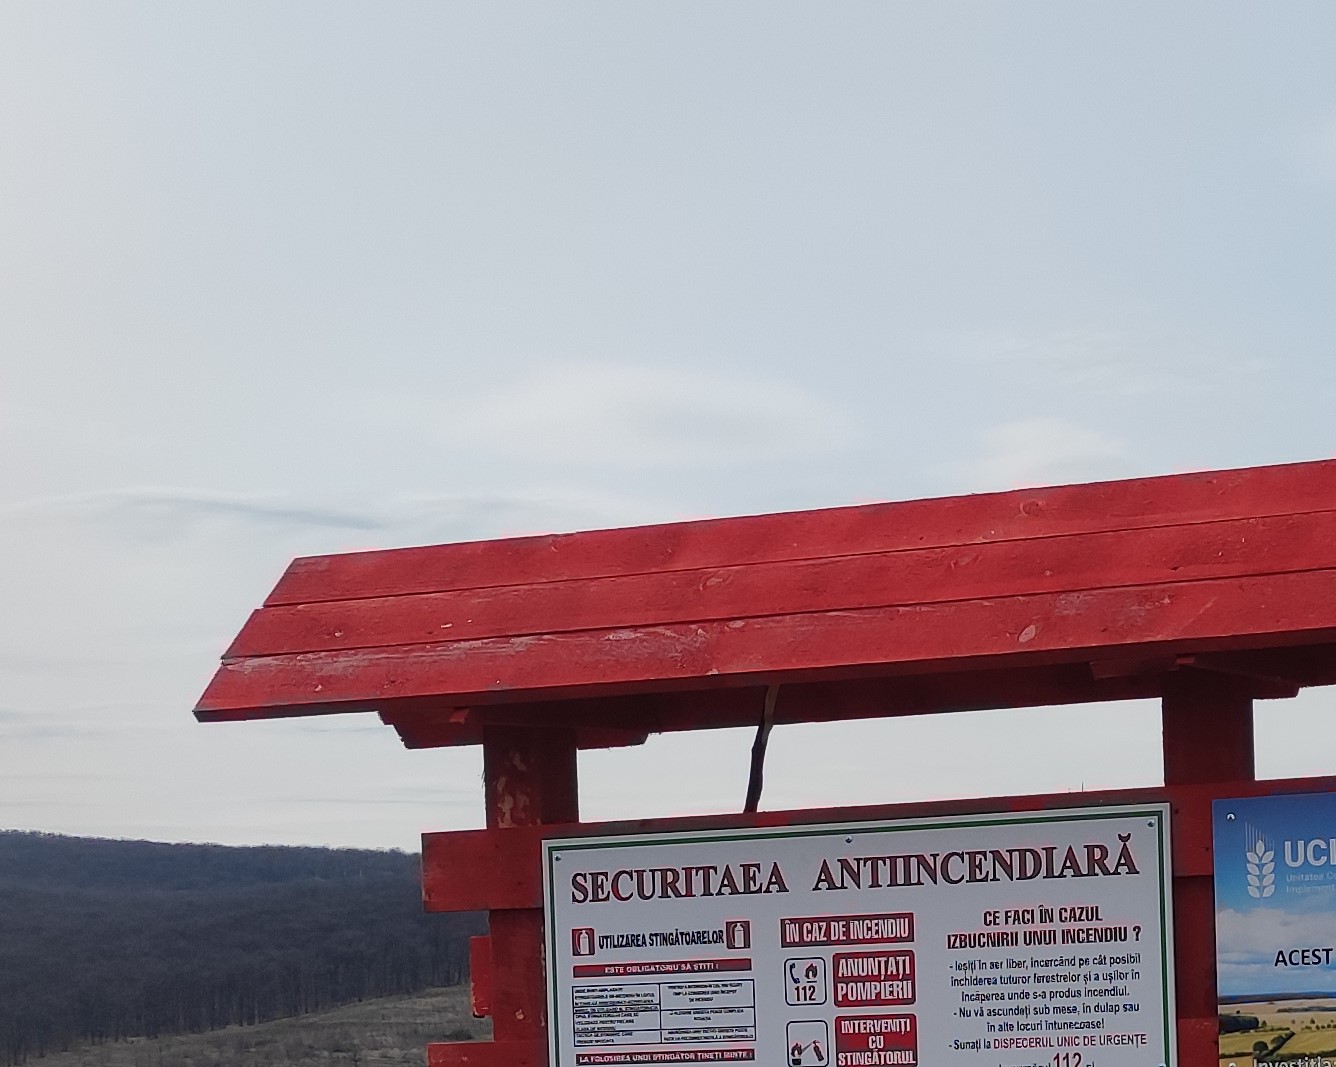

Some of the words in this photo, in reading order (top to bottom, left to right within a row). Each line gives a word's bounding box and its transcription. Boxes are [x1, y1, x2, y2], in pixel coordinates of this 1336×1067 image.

[572, 862, 789, 904] SECURITAEA
[812, 832, 1140, 891] ANTIINCENDIARĂ
[984, 911, 1000, 926] CE
[1005, 909, 1034, 925] FACI
[1038, 904, 1053, 923] ÎN
[1059, 906, 1103, 923] CAZUL
[599, 934, 647, 949] UTILIZAREA
[649, 929, 724, 946] STINGĂTOARELOR
[785, 920, 798, 942] ÎN
[803, 922, 827, 941] CAZ
[831, 921, 846, 940] DE
[947, 932, 1018, 949] IZBUCNIRII
[1024, 930, 1057, 946] UNUI
[1062, 927, 1127, 944] INCENDIU
[1006, 958, 1028, 970] liber,
[1109, 953, 1140, 967] posibil
[1274, 948, 1333, 967] ACEST
[838, 956, 910, 980] ANUNȚAȚI
[1000, 974, 1030, 985] tuturor
[794, 986, 816, 1001] 112
[838, 981, 912, 1001] POMPIERII
[1008, 989, 1030, 1000] unde
[1050, 988, 1081, 1000] produs
[959, 1007, 971, 1018] Nu
[1033, 1004, 1050, 1015] sub
[1094, 1002, 1119, 1014] dulap
[1123, 1003, 1139, 1012] sau
[842, 1019, 910, 1034] INTERVENIȚI
[998, 1021, 1014, 1031] alte
[1017, 1019, 1042, 1031] locuri
[868, 1036, 884, 1048] CU
[994, 1035, 1054, 1049] DISPECERUL
[1057, 1035, 1080, 1047] UNIC
[1083, 1035, 1096, 1046] DE
[838, 1049, 916, 1066] STINGĂTORUL
